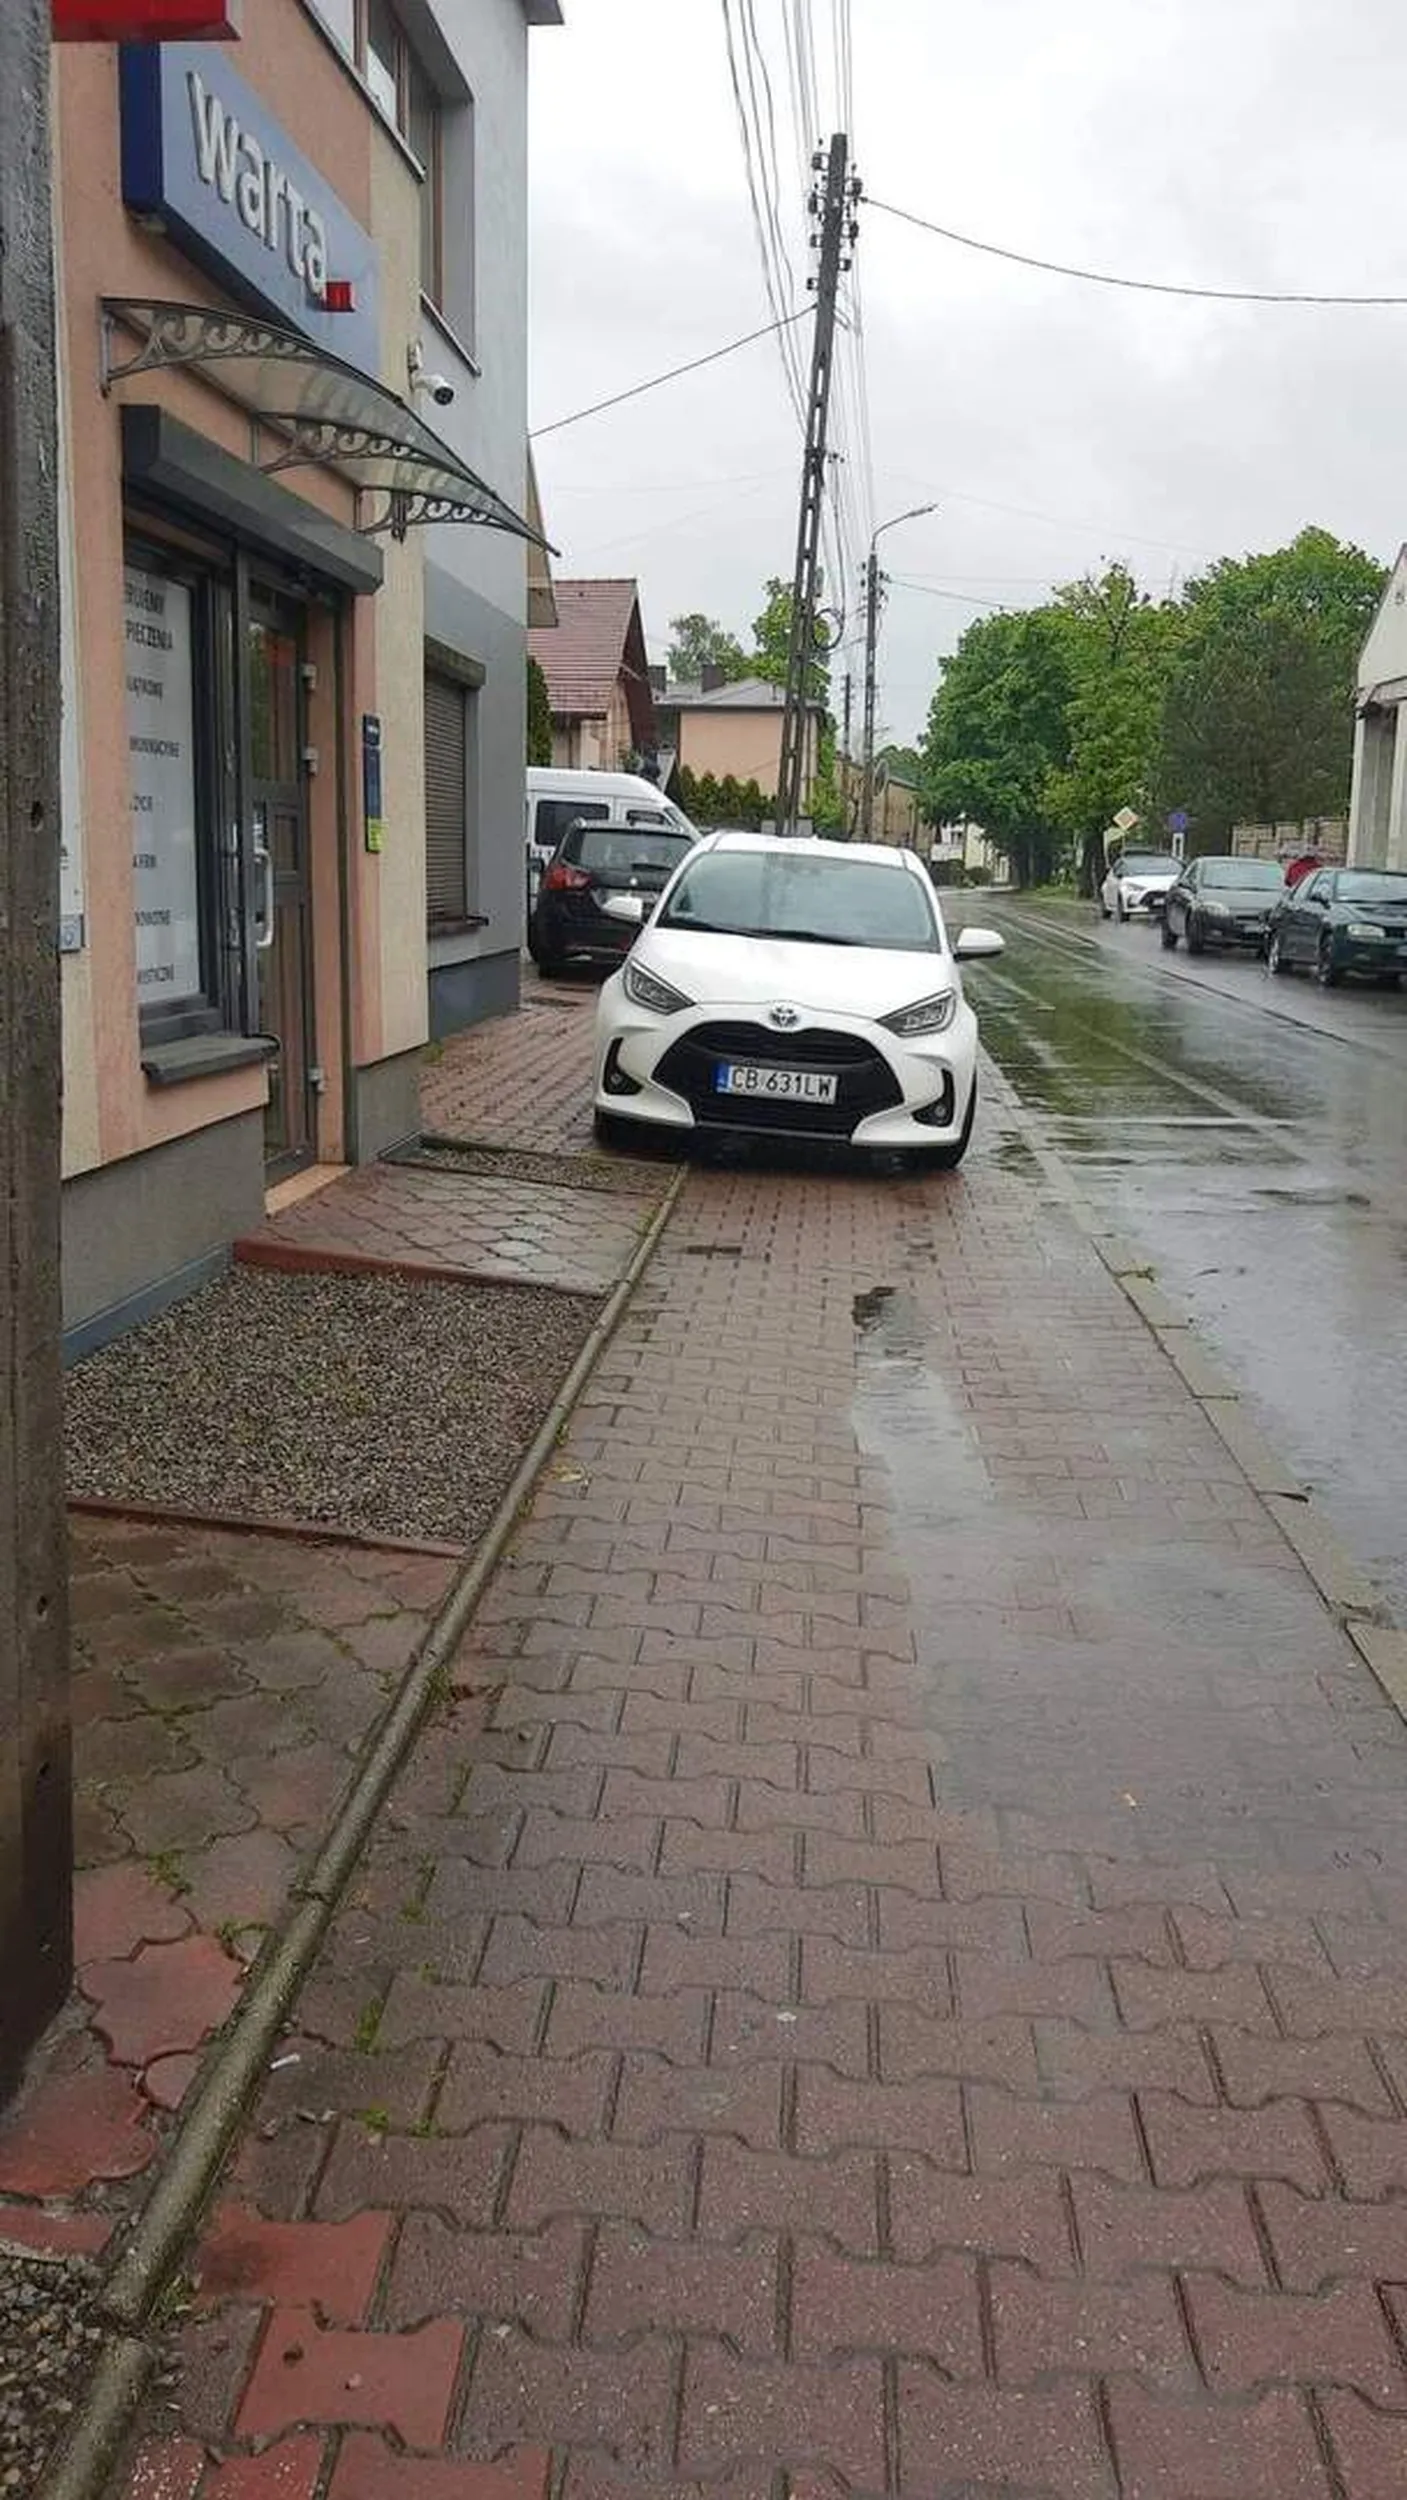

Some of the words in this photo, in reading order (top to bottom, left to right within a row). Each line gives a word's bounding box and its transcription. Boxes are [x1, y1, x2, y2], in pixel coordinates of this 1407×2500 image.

[186, 71, 327, 303] warta
[732, 1067, 758, 1089] CB
[766, 1072, 832, 1098] 631LW
